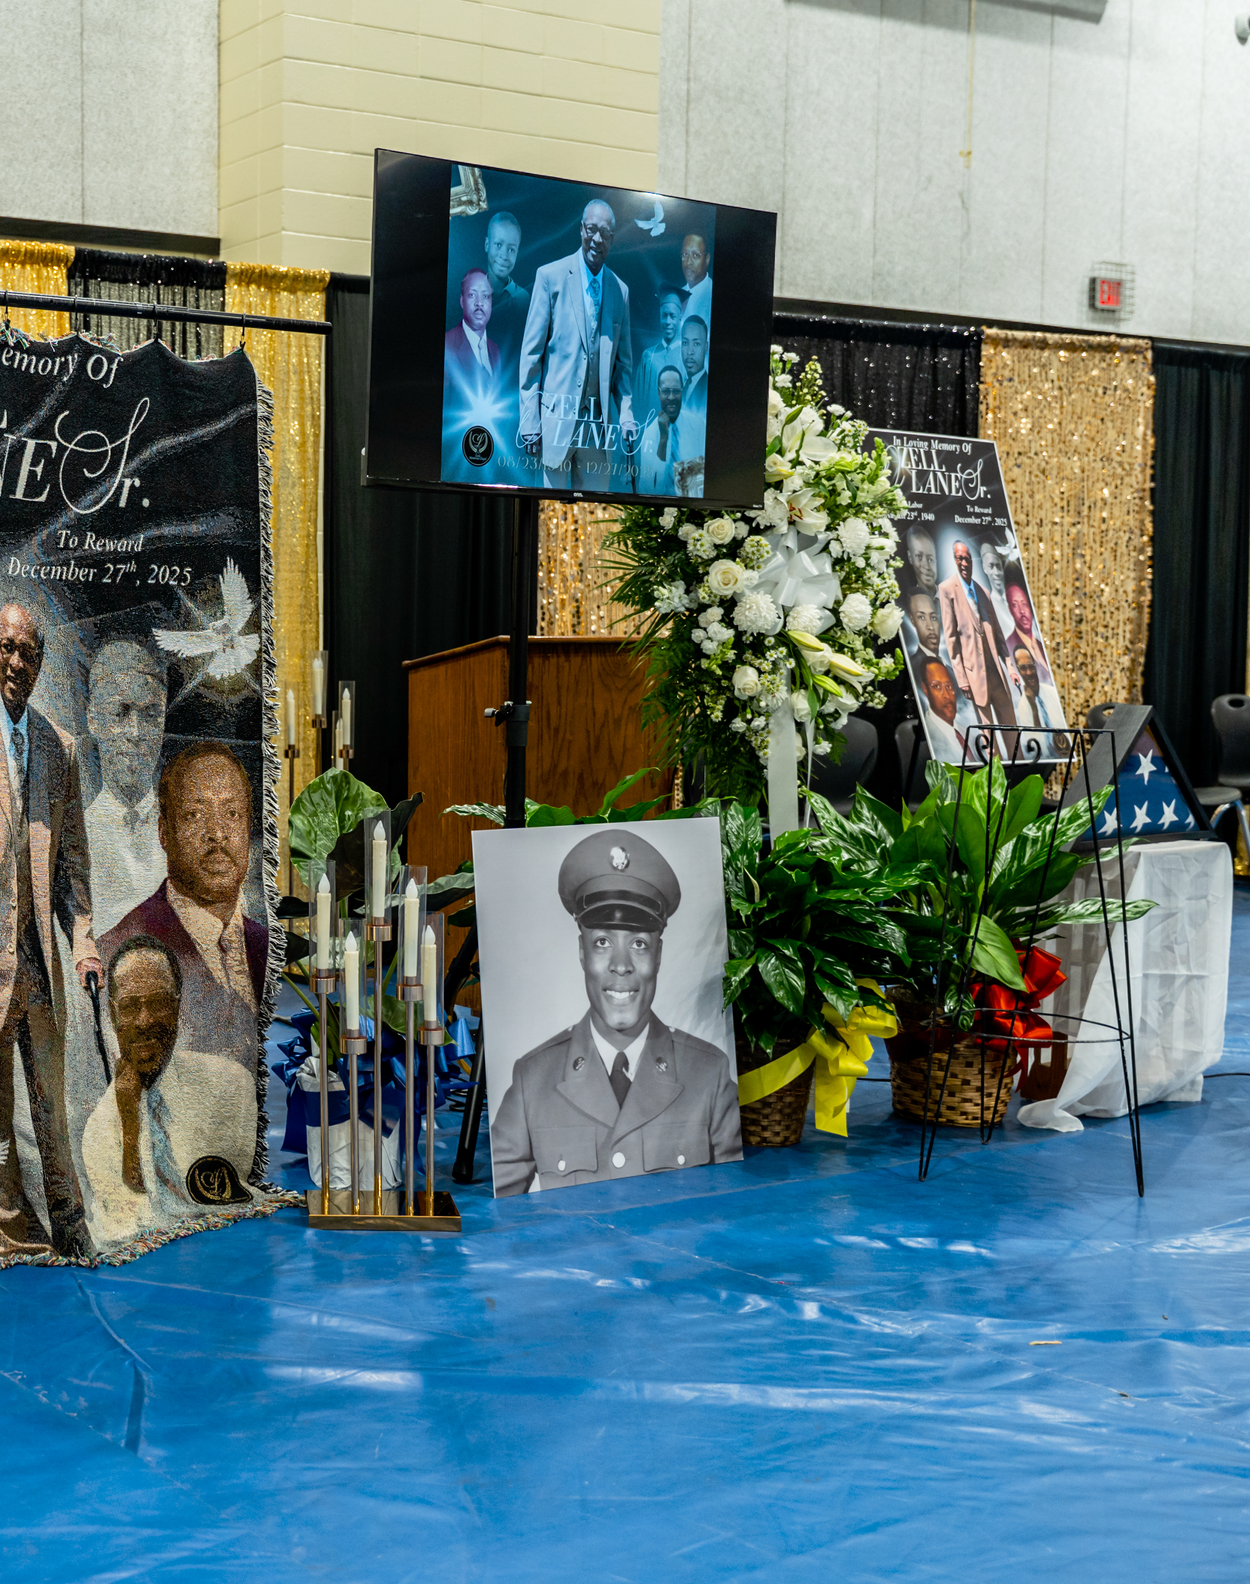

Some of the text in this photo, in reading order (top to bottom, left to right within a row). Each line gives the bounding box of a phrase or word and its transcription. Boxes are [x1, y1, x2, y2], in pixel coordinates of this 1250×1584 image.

[86, 353, 124, 389] Of
[551, 419, 621, 450] LANE
[892, 435, 972, 455] In Loving Memory Of
[497, 455, 572, 473] 08/23/190
[911, 470, 963, 497] LANE
[921, 512, 935, 521] 1940
[954, 514, 981, 524] December
[994, 517, 1008, 527] 2025
[974, 506, 992, 514] Reward
[57, 530, 144, 552] To Reward
[7, 556, 97, 582] December
[147, 563, 192, 587] 2025
